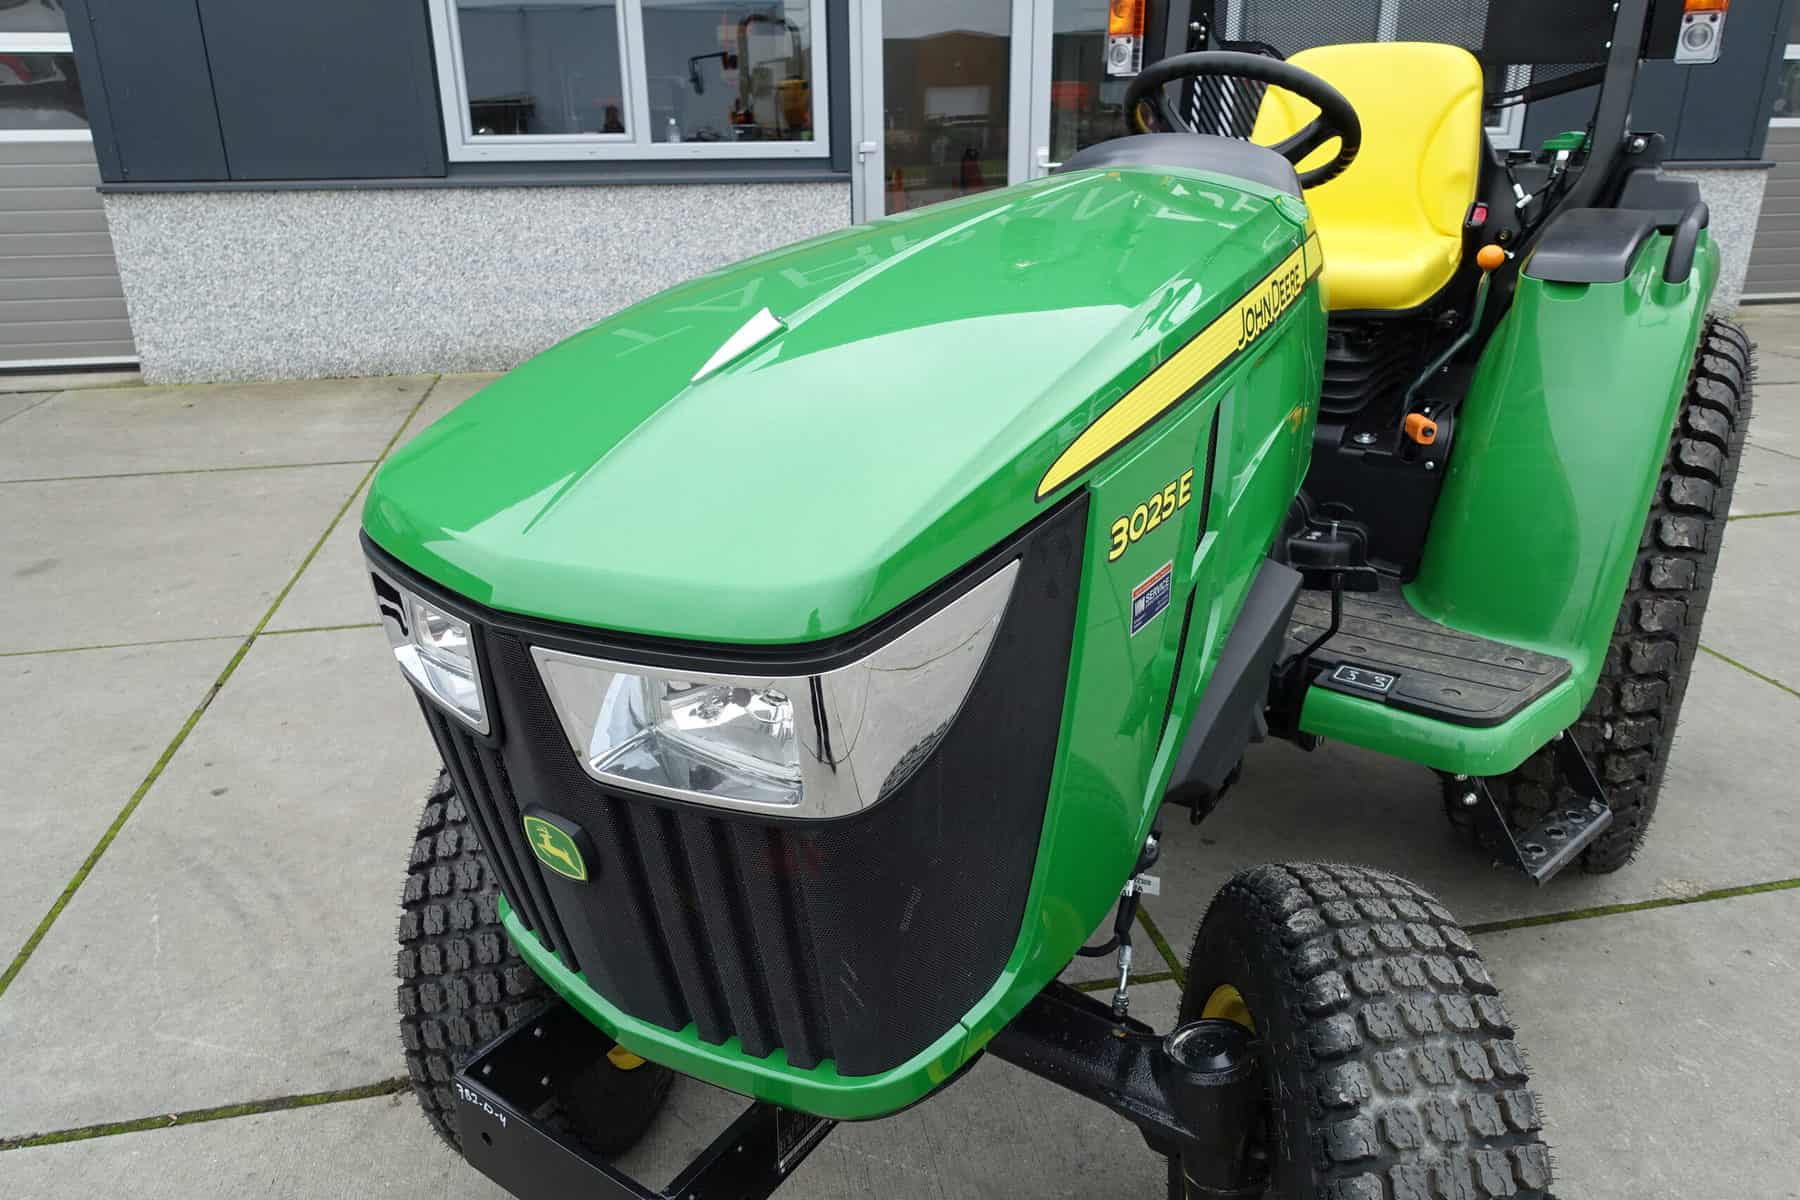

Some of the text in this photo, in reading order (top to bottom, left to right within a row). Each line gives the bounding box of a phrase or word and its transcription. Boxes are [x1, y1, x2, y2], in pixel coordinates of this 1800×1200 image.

[1238, 265, 1301, 344] JOHN DEERE
[1107, 466, 1194, 563] 3025E
